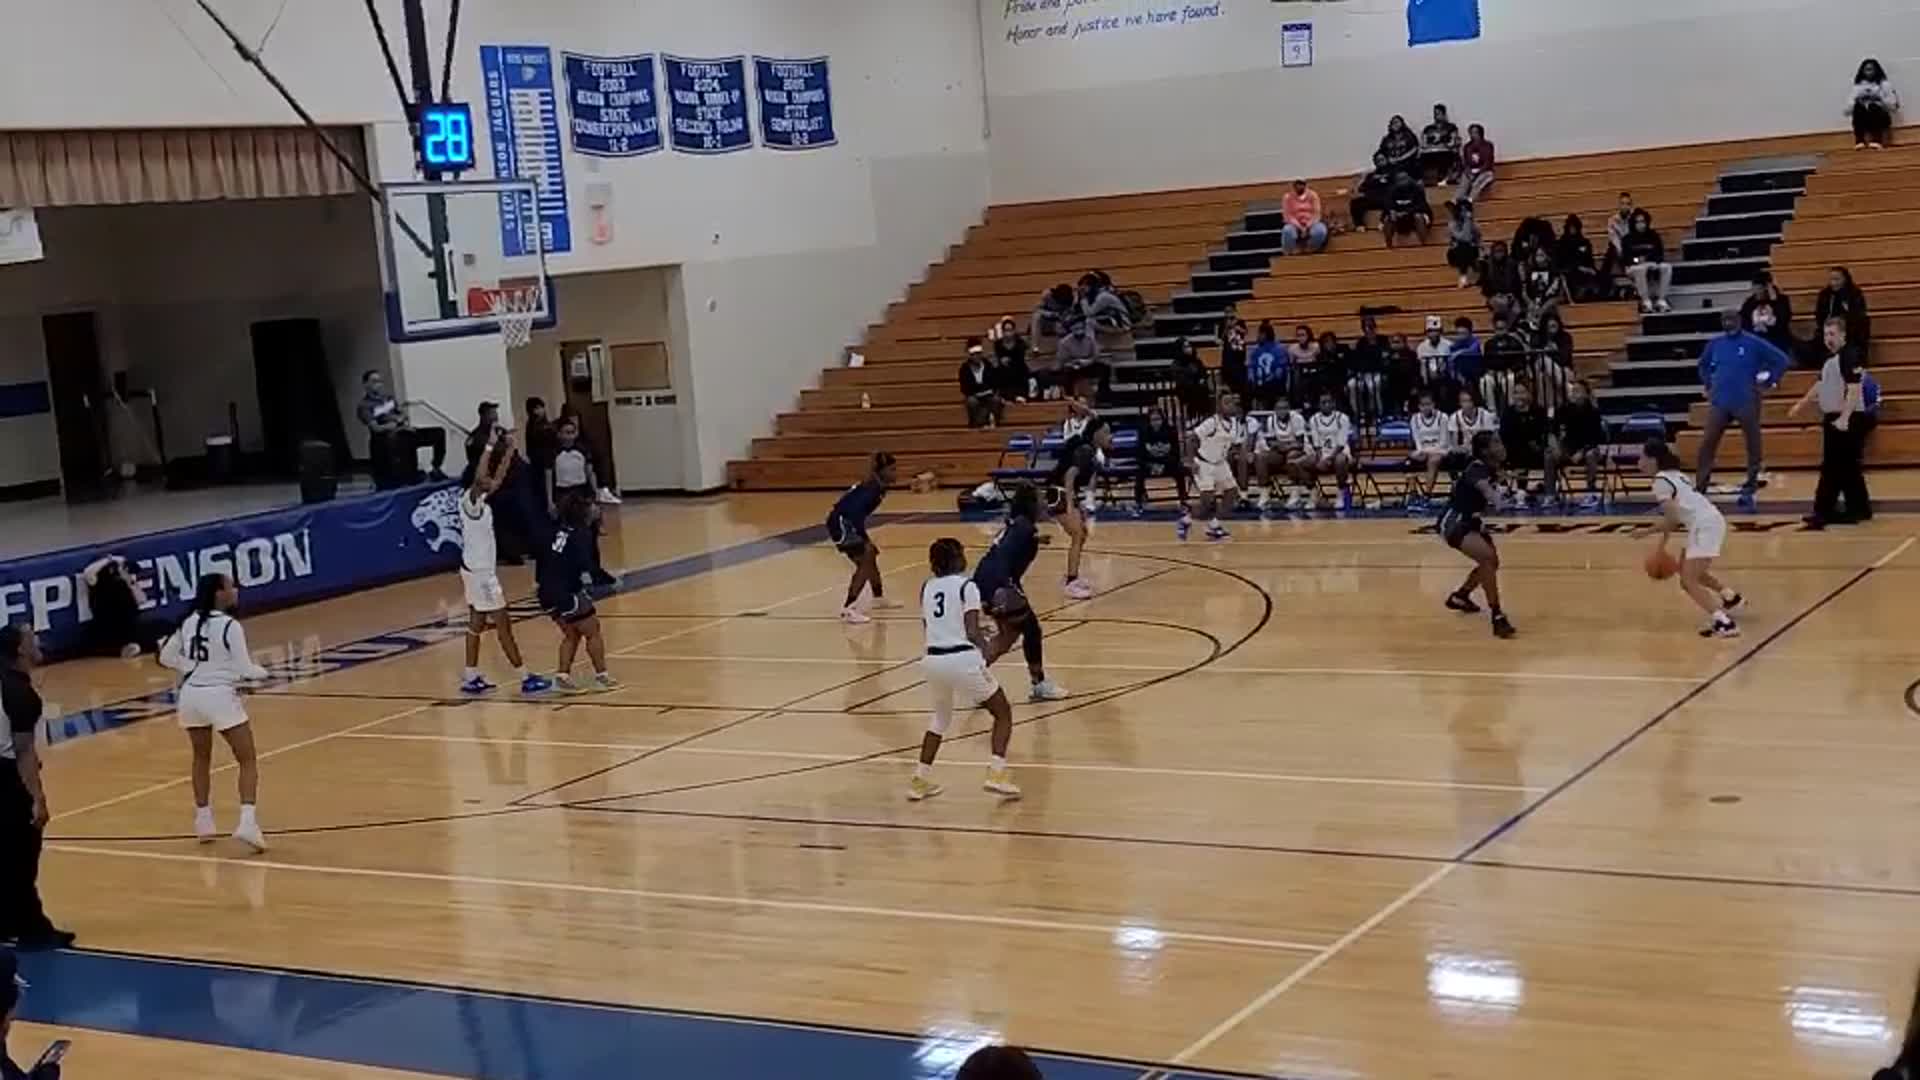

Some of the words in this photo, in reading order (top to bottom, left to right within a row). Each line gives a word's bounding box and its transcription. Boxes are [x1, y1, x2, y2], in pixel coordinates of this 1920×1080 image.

[1007, 23, 1042, 45] Honor
[1046, 20, 1069, 37] and
[1071, 17, 1119, 40] justice
[1147, 8, 1177, 24] have
[583, 61, 637, 77] FOOTBALL
[681, 63, 728, 78] FOOTBALL
[771, 64, 815, 78] FOOTBALL
[599, 78, 626, 92] 2003
[694, 79, 720, 92] 2004
[487, 70, 505, 132] JAGUARS
[600, 107, 631, 122] STATE
[696, 106, 722, 120] STATE
[783, 105, 809, 118] STATE
[426, 112, 468, 163] 28
[933, 592, 945, 618] 3
[188, 635, 209, 662] 15
